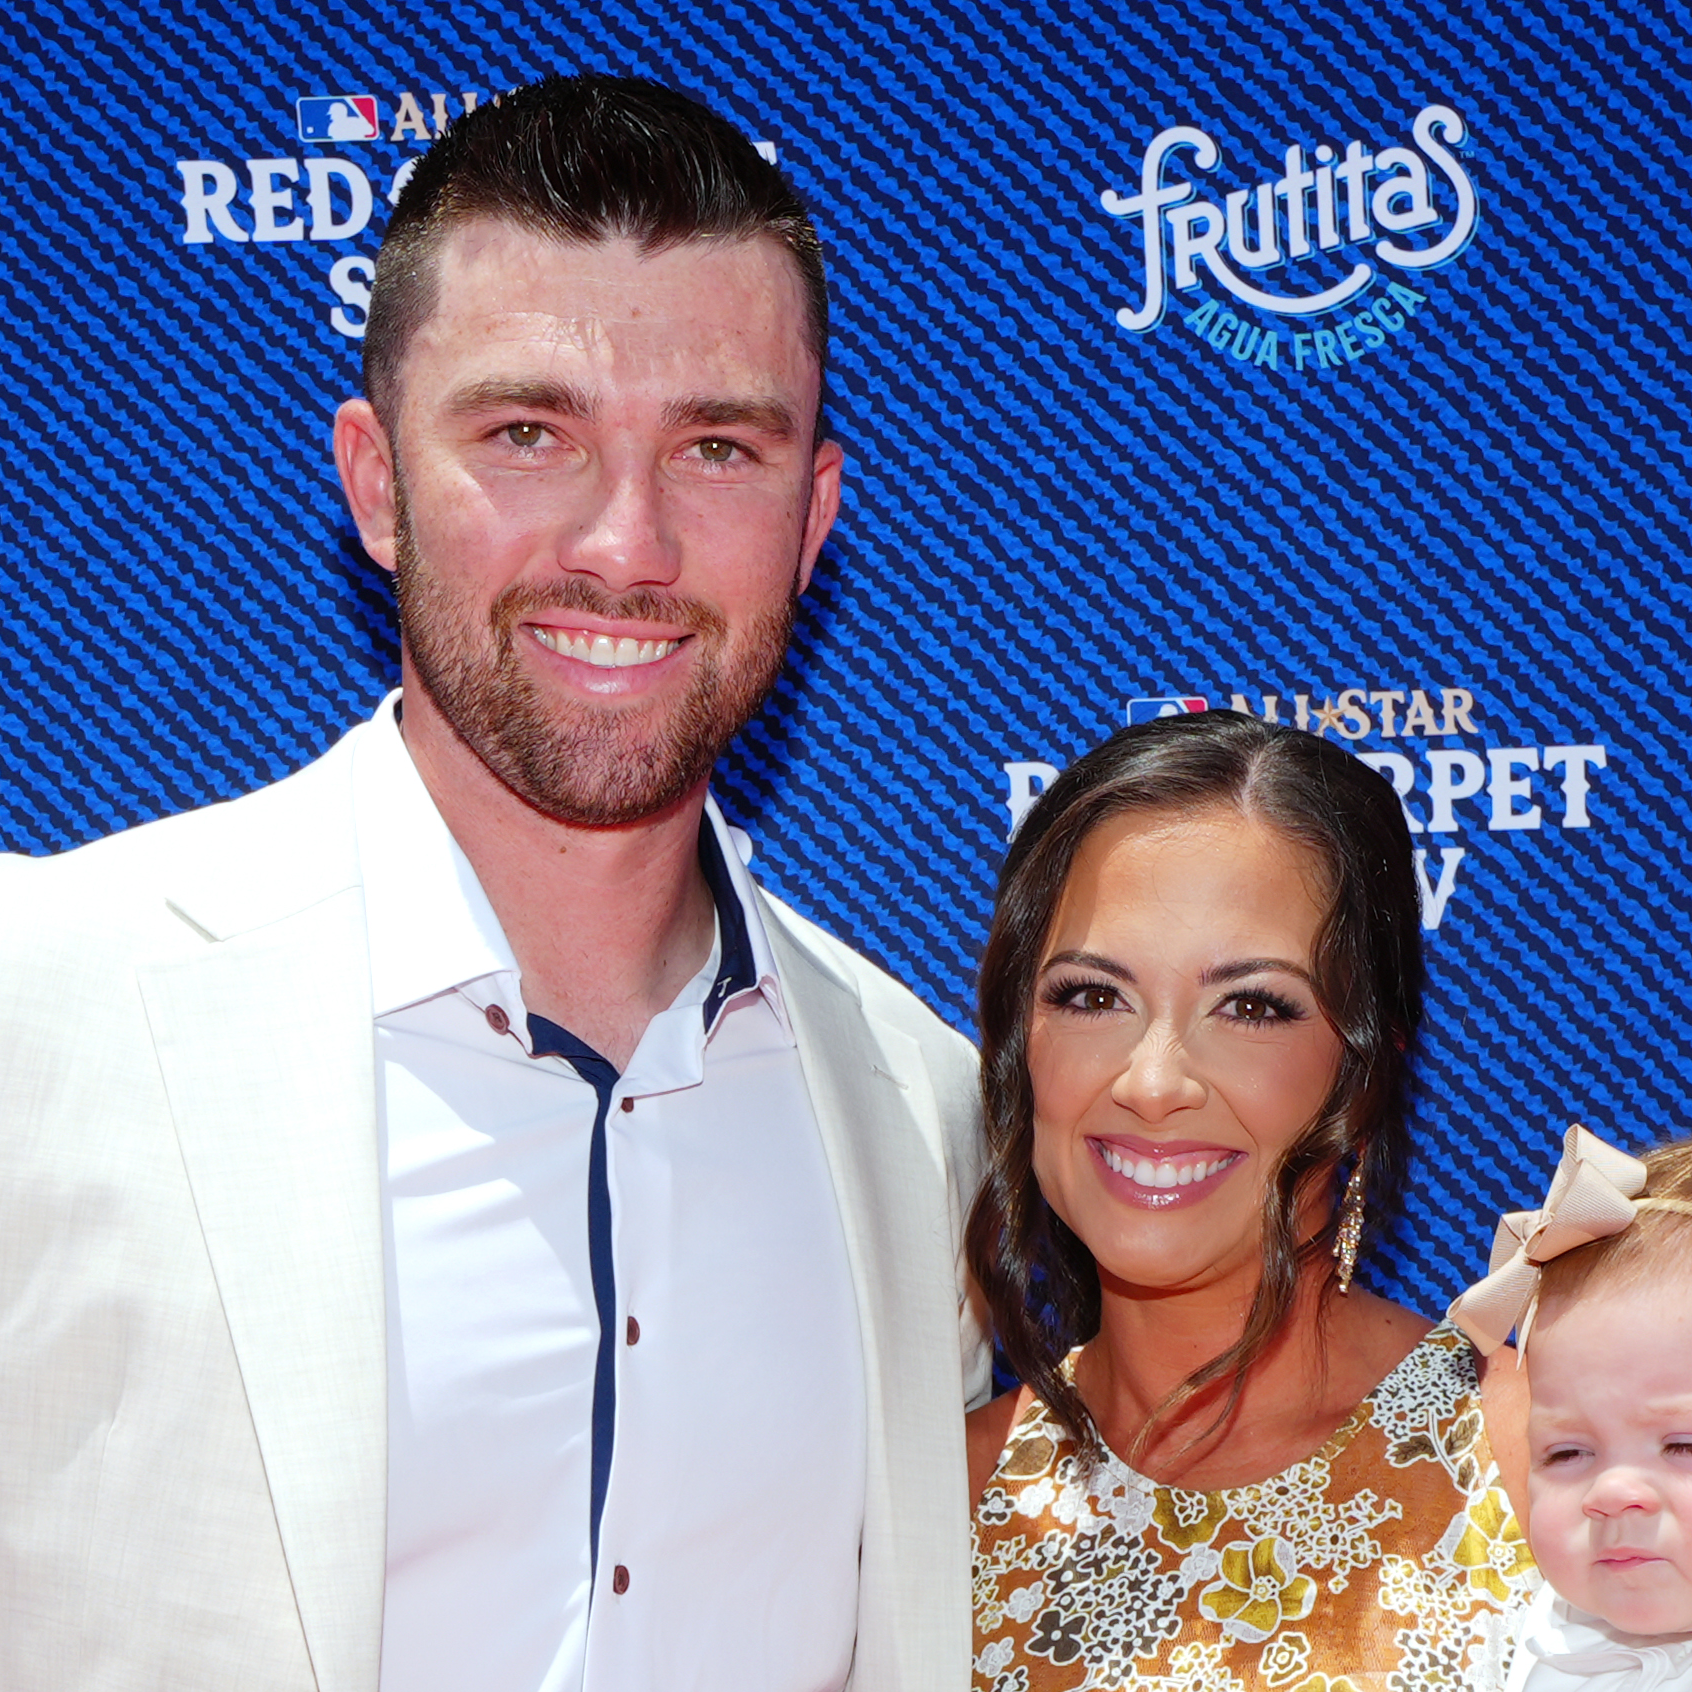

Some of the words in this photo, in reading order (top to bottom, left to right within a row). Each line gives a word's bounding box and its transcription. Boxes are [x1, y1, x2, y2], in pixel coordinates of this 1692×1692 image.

[177, 158, 372, 243] RED
[1183, 298, 1278, 371] AGUA
[1294, 280, 1427, 371] FRESCA
